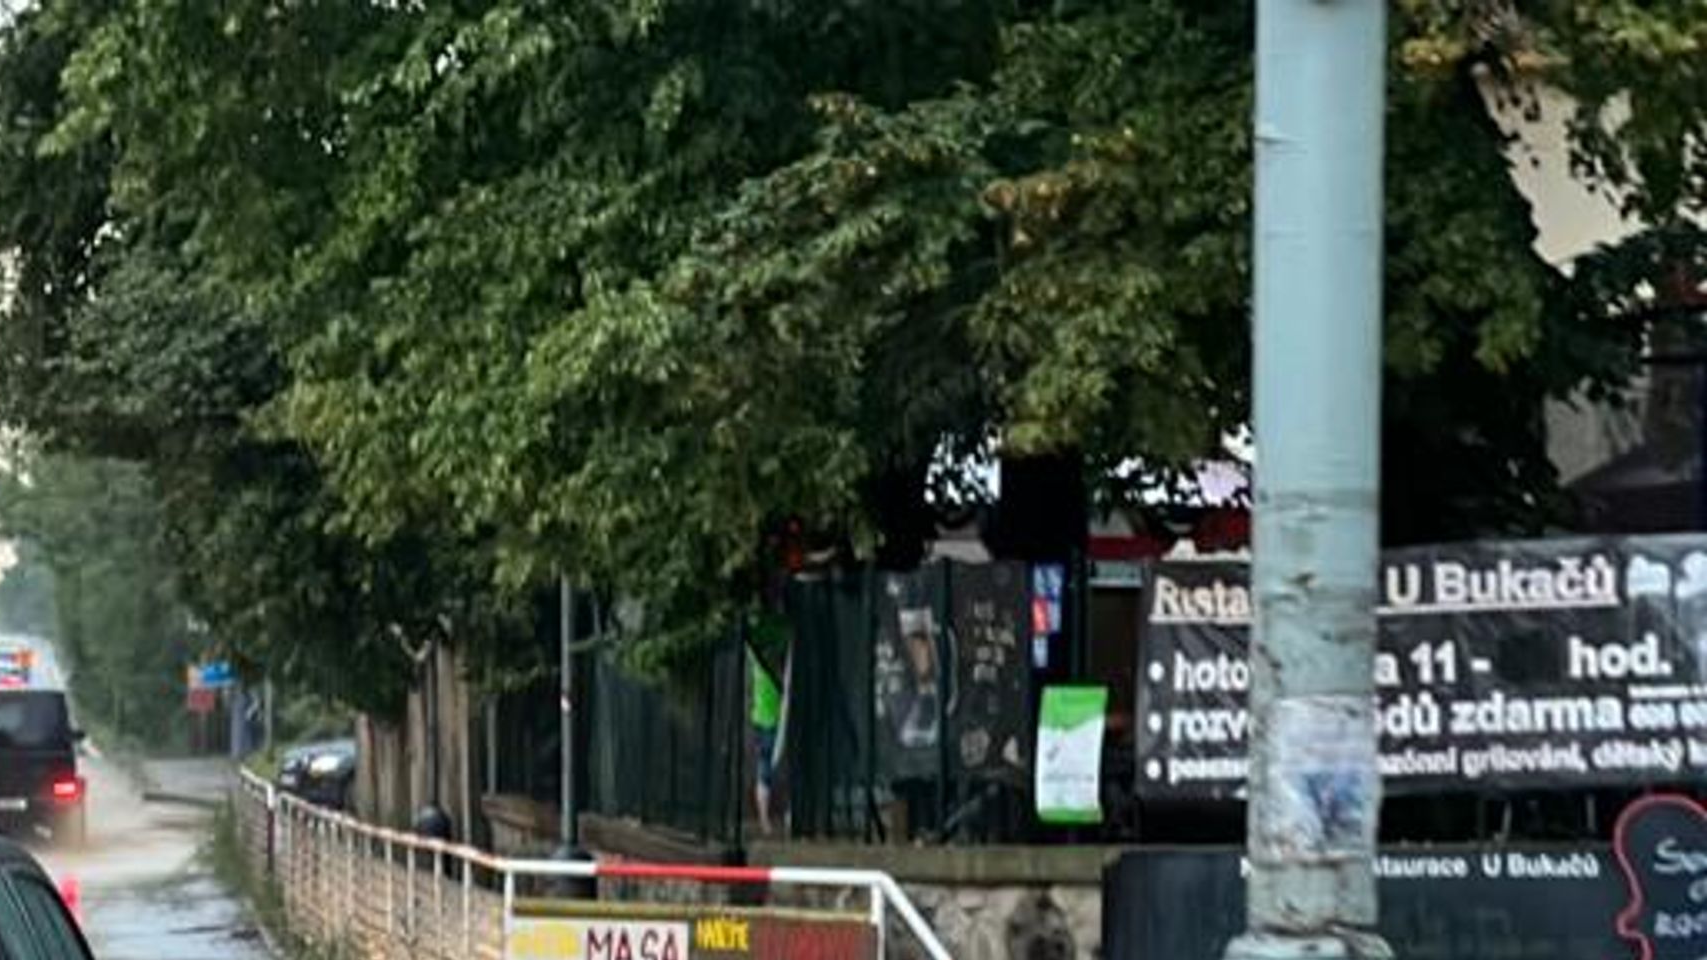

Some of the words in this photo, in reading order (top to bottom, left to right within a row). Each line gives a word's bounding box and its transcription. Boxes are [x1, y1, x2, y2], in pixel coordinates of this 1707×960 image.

[1386, 565, 1421, 605] U
[1434, 554, 1616, 603] Bukačů
[1173, 652, 1250, 692] hoto
[1373, 653, 1400, 686] a
[1410, 640, 1457, 683] 11
[1568, 632, 1674, 678] hod.
[1170, 709, 1252, 744] rozv
[1450, 691, 1625, 735] zdarma
[1483, 853, 1501, 878] U
[1507, 852, 1599, 878] Bukačů
